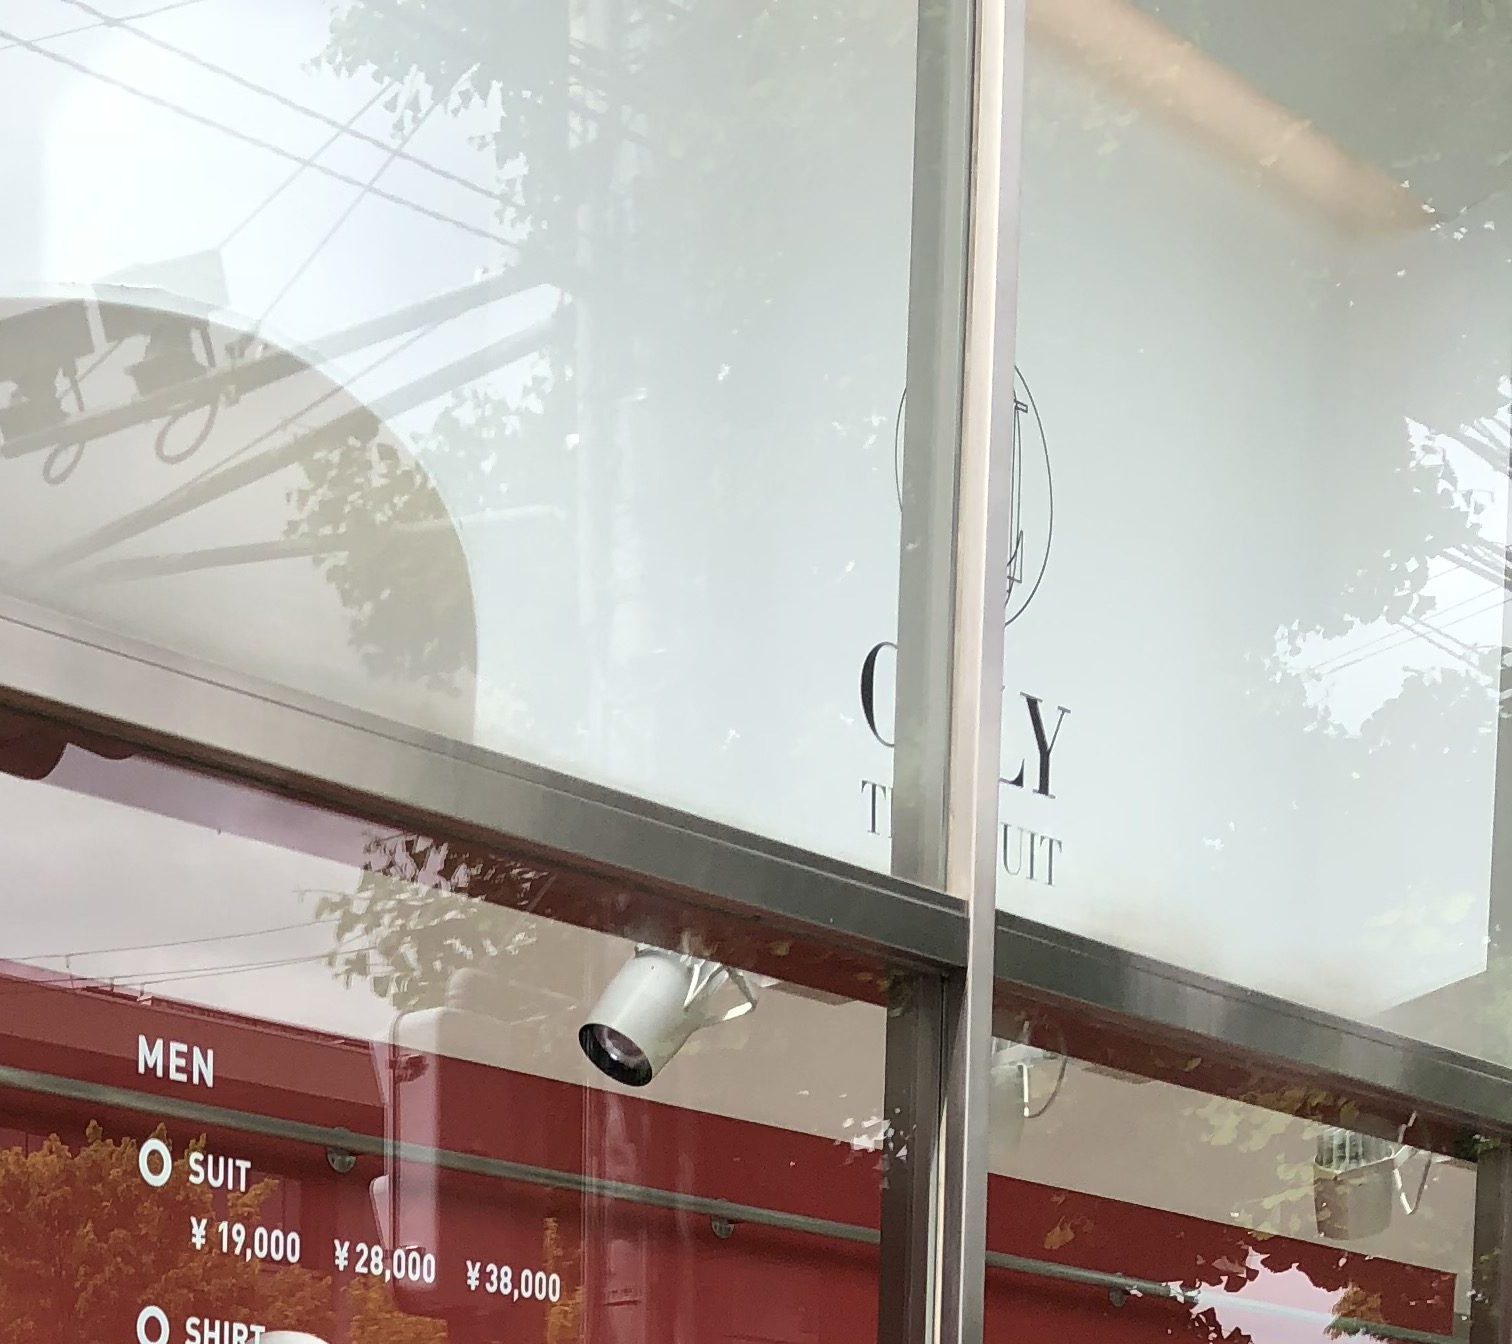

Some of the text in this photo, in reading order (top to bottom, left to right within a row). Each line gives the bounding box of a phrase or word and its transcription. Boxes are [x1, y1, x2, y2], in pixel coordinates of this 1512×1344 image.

[861, 641, 1071, 799] OY
[999, 821, 1063, 888] UIT
[138, 1035, 214, 1088] MEN
[188, 1152, 251, 1193] SUIT
[334, 1239, 436, 1284] ¥28,000
[466, 1260, 561, 1303] ¥38,000
